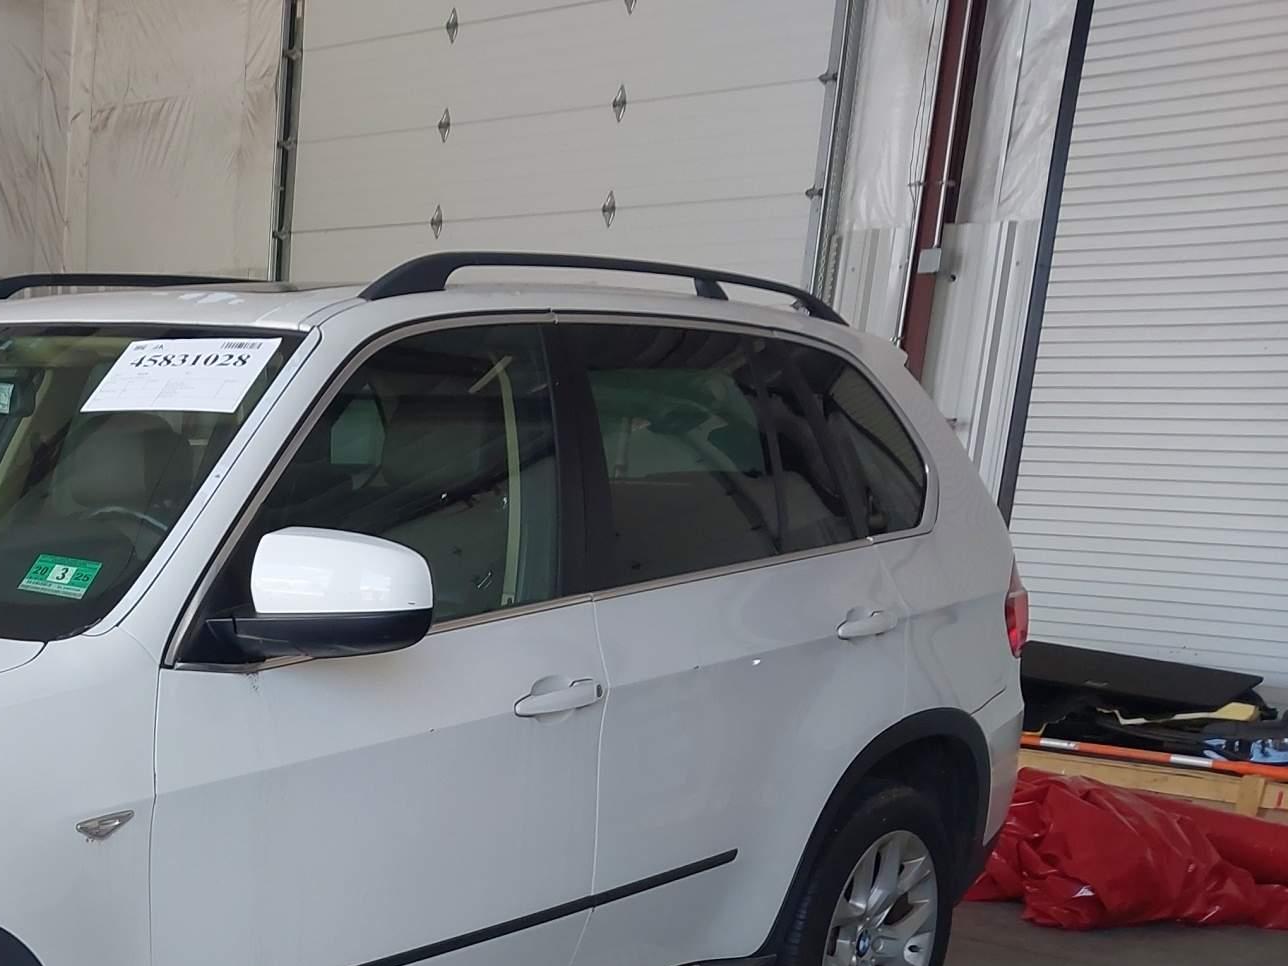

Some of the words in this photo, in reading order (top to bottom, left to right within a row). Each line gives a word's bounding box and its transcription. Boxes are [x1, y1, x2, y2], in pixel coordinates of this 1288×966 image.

[130, 353, 251, 368] 45831028
[56, 567, 69, 581] 3
[74, 572, 90, 582] 25
